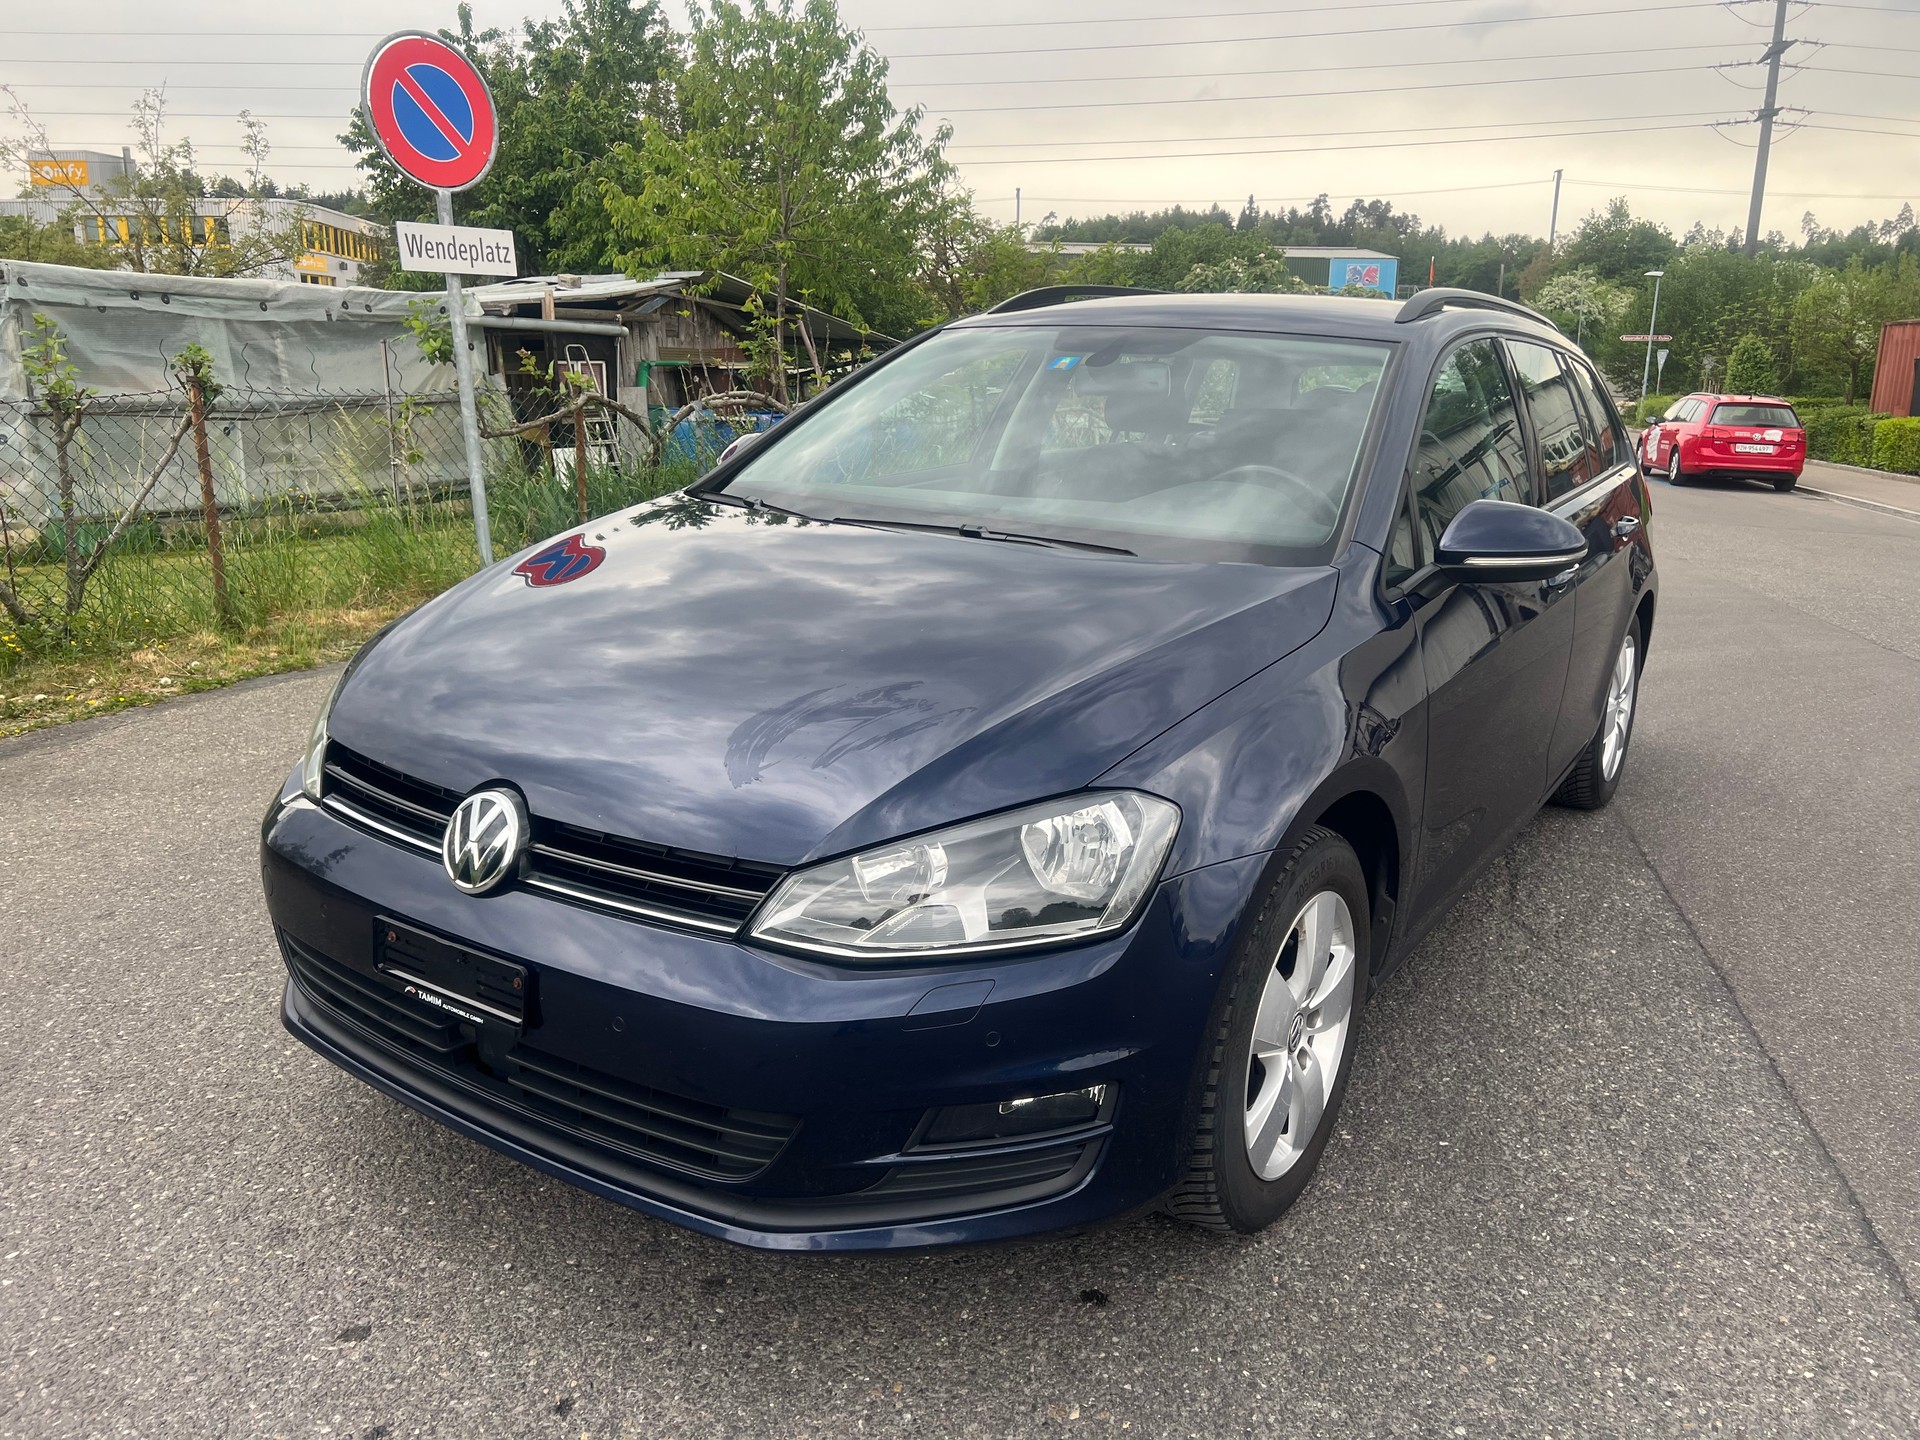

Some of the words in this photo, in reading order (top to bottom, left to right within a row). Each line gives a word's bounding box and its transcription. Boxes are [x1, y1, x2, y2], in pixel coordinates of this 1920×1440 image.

[404, 232, 511, 268] Wendeplatz
[417, 990, 442, 1006] TAMIM
[442, 1003, 470, 1019] AUTOMOBILE
